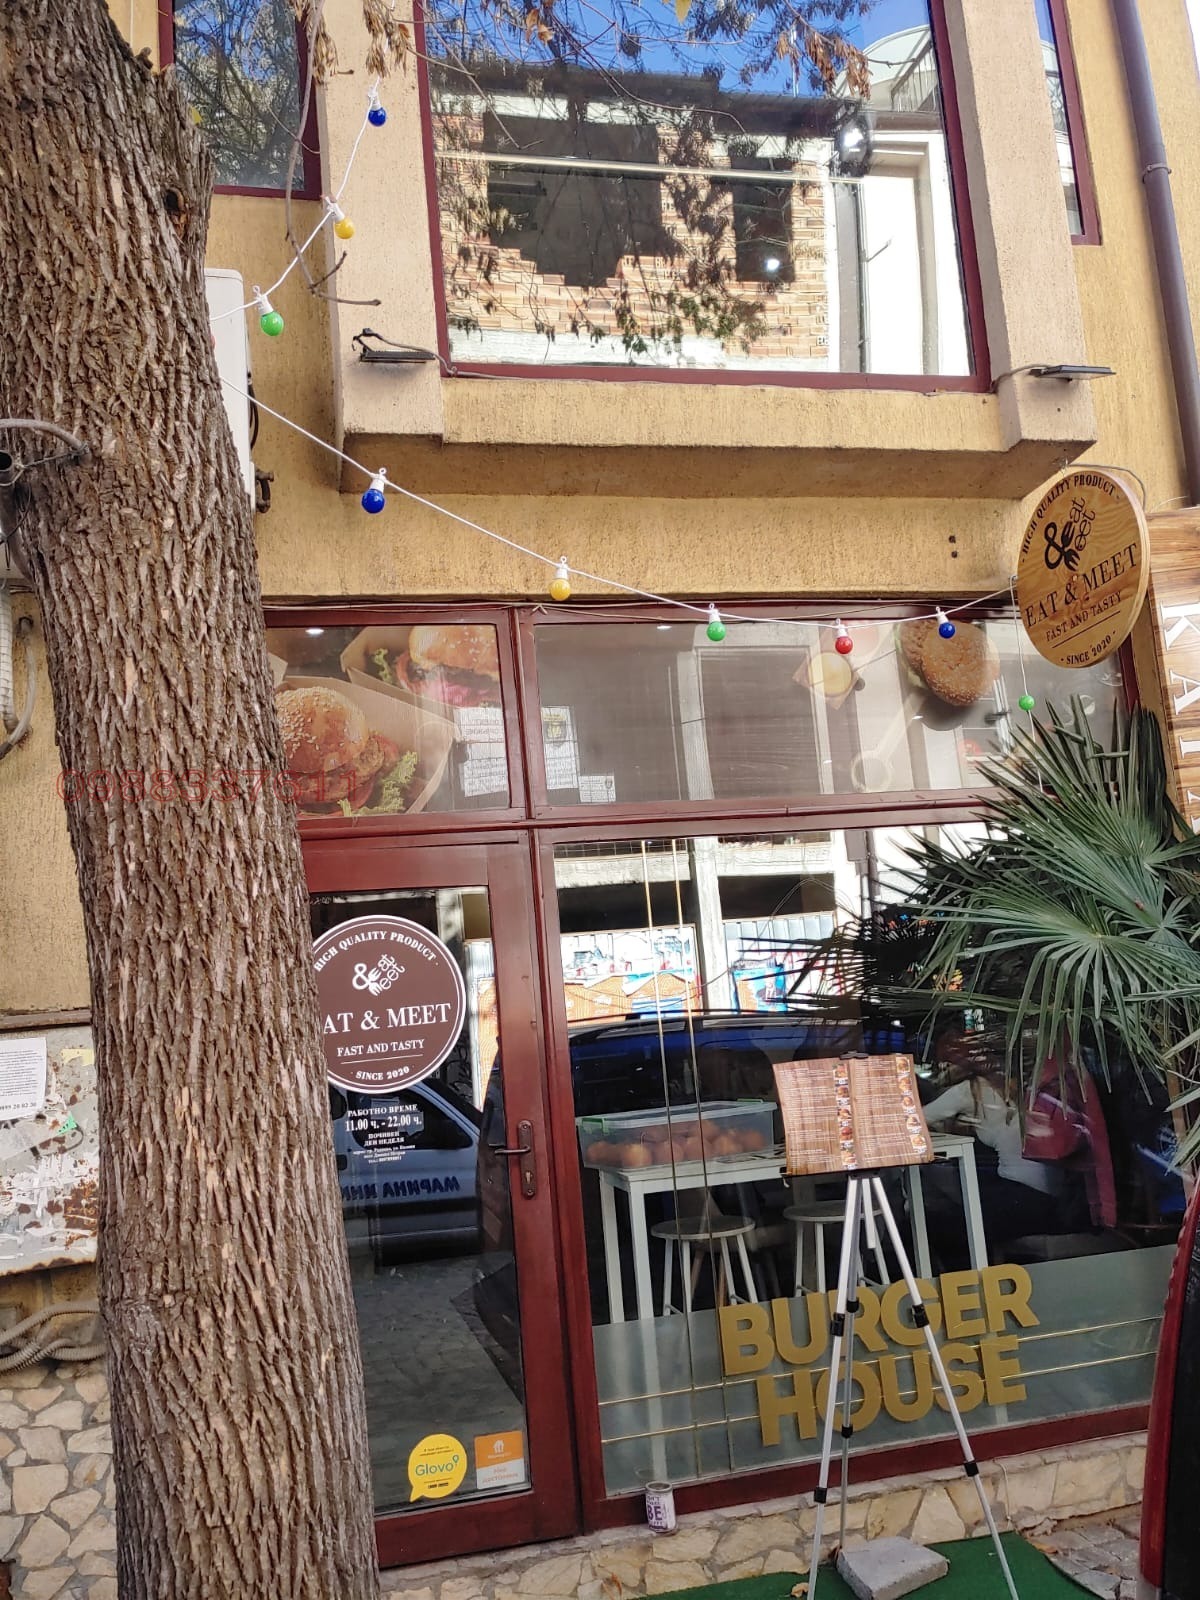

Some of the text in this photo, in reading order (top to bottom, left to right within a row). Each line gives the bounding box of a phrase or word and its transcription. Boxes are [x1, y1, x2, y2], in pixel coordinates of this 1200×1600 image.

[1022, 474, 1116, 554] HIGH QUALITY PRODUCT
[1024, 543, 1137, 628] EAT & MEET
[1046, 591, 1121, 642] FAST AND TASTY
[1066, 635, 1112, 665] SINCE 2020
[313, 931, 437, 972] HIGH QUALITY PRODUCT
[323, 1002, 452, 1034] AT & MEET
[337, 1039, 425, 1057] FAST AND TASTY
[355, 1066, 410, 1081] SINCE 2020
[345, 1118, 369, 1132] 11.00
[387, 1114, 411, 1128] 22.00
[347, 1103, 418, 1118] РАБОТНО ВРЕМЕ
[719, 1263, 1040, 1376] BURGER
[756, 1334, 1027, 1447] HOUSE
[415, 1460, 454, 1476] Glovo
